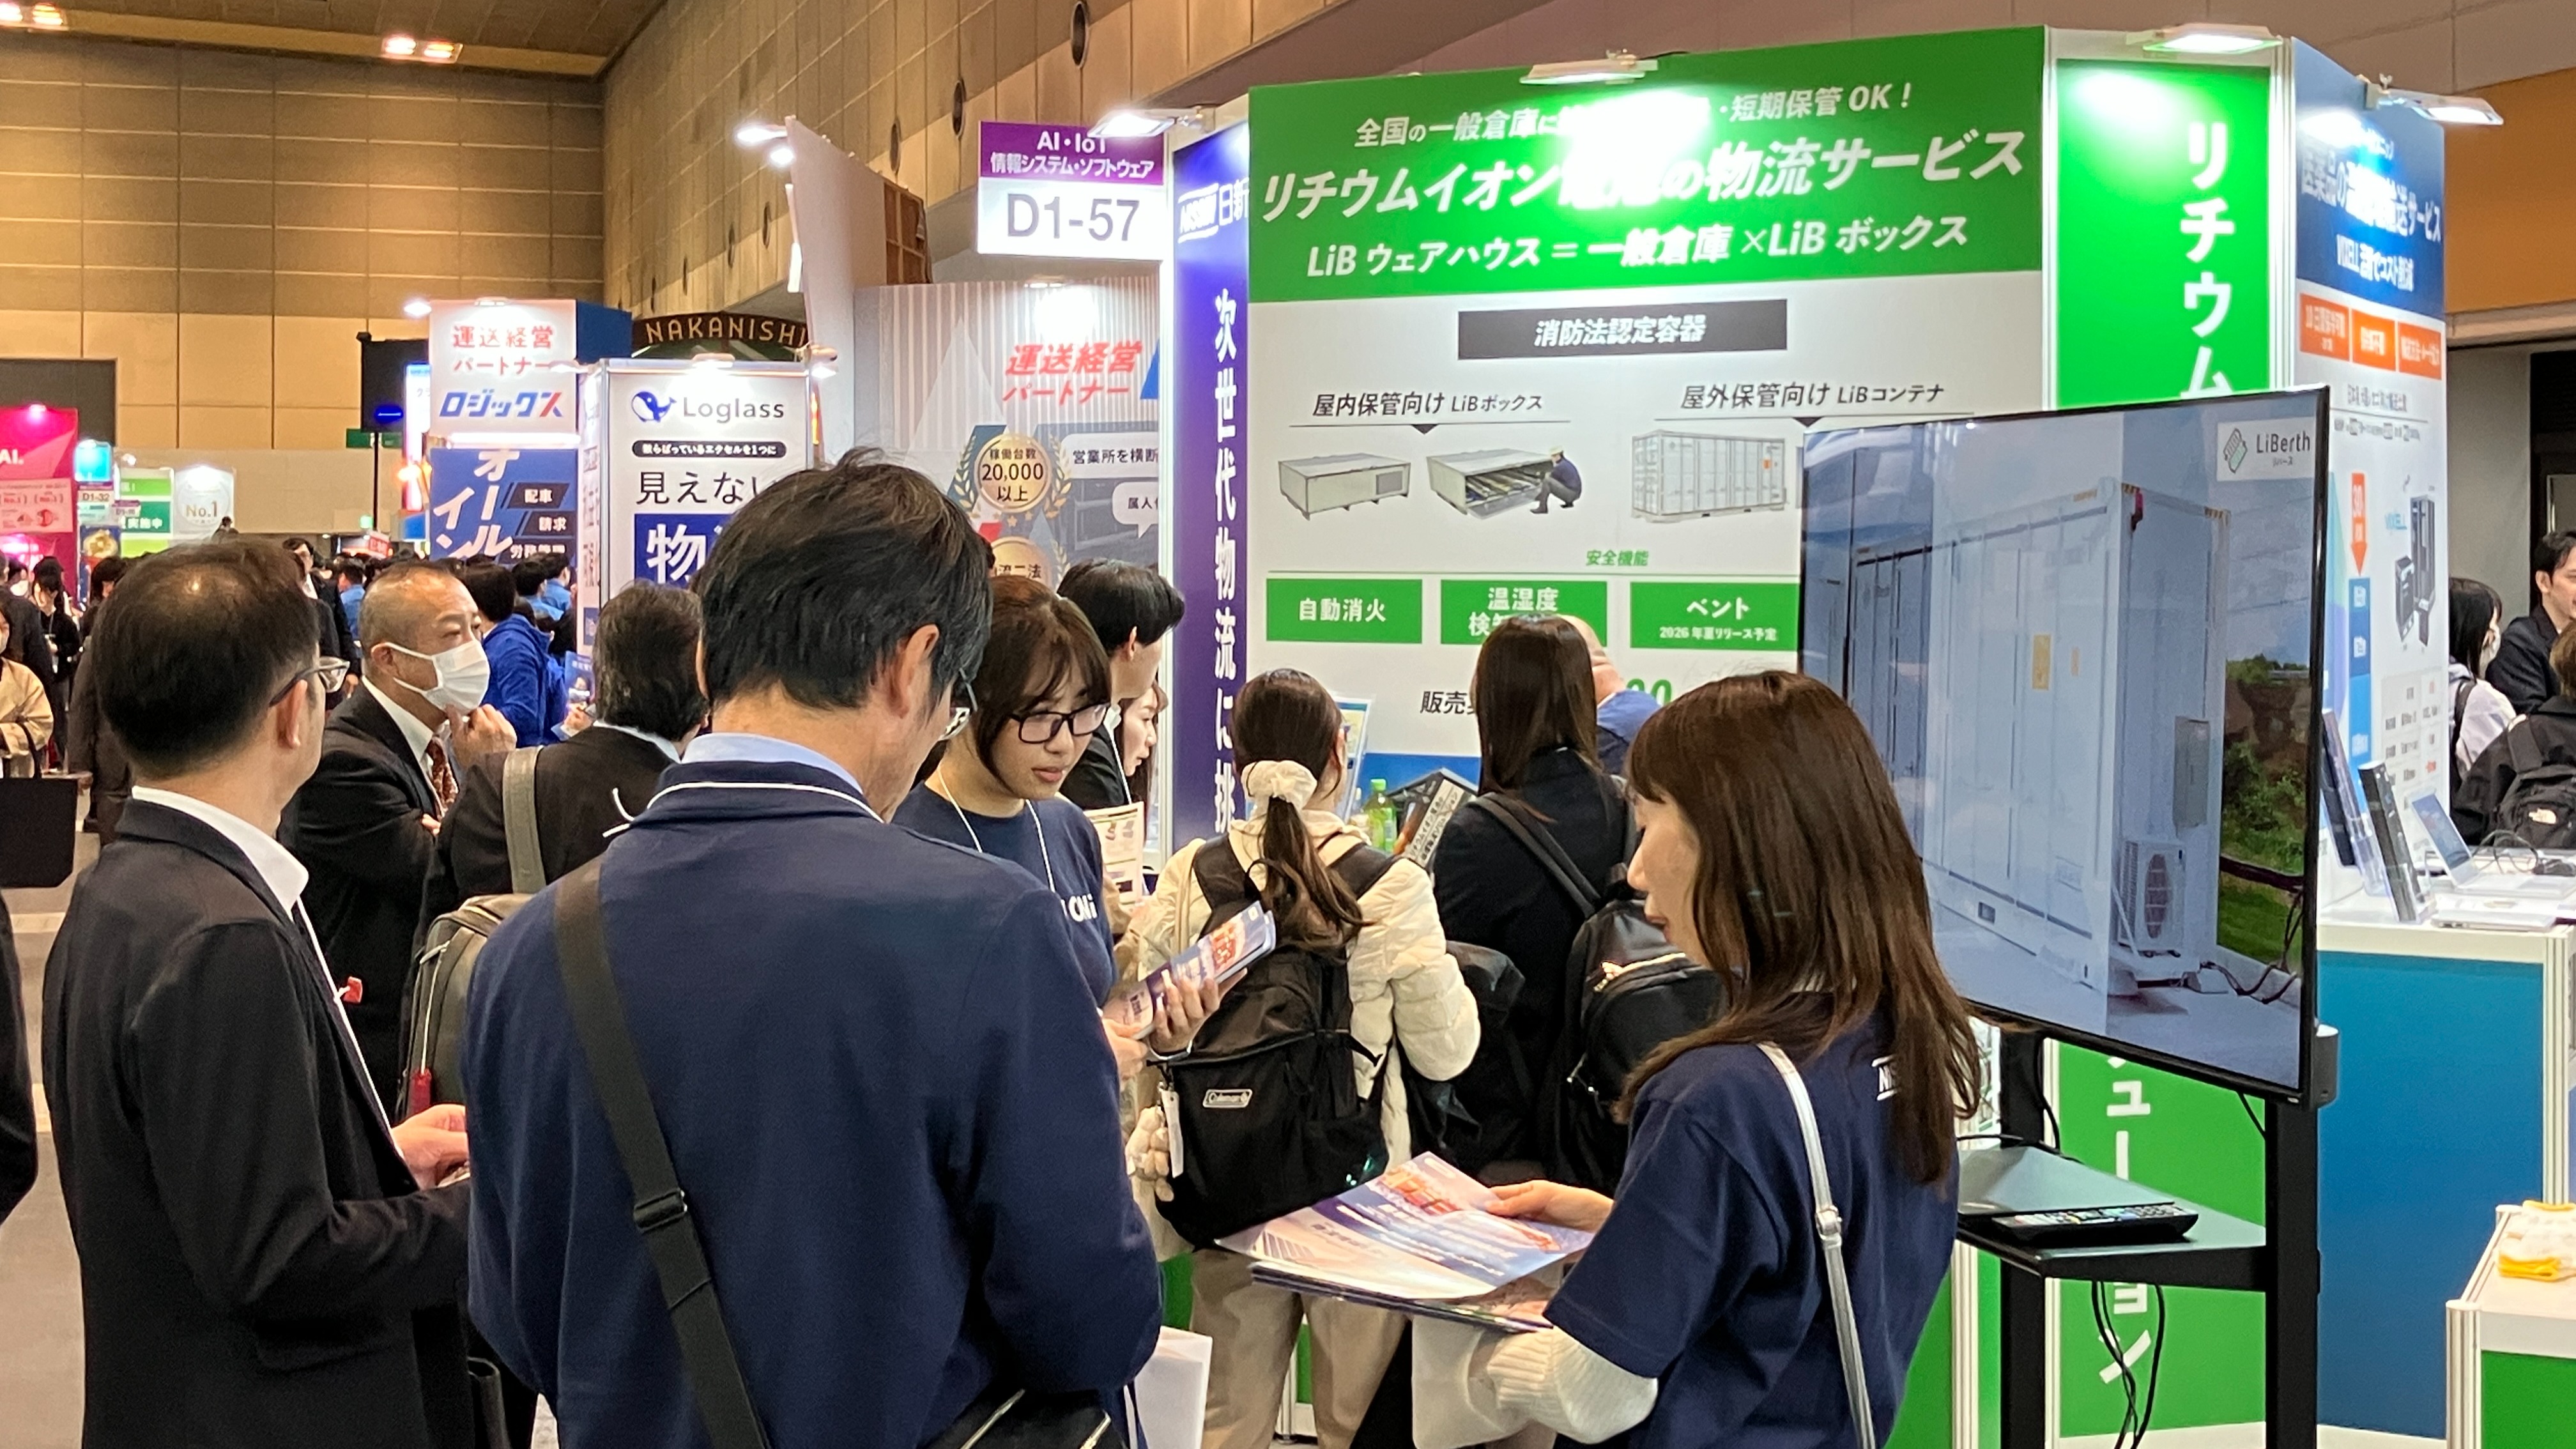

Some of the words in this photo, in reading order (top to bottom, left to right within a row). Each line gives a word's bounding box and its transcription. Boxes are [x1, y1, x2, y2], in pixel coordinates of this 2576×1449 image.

[990, 151, 1154, 179] 情報システム・ソフトウェア
[1263, 128, 2025, 222] リチウムイオンの物流サービス
[1007, 193, 1140, 241] D1-57
[2179, 121, 2235, 399] リチウム
[453, 325, 554, 349] 運送経営
[646, 317, 807, 347] NAKANISHI
[1534, 314, 1706, 347] 消防法認定容器
[454, 356, 551, 376] パートナー
[1005, 341, 1143, 376] 運送経営
[440, 388, 564, 417] ロジックス
[1002, 379, 1130, 406] パートナー
[683, 397, 785, 424] Loglass
[2256, 430, 2311, 454] LiBerth
[990, 448, 1037, 461] 稼働台数
[982, 463, 1043, 482] 20,000
[525, 489, 553, 503] 配車
[997, 486, 1028, 502] 以上
[186, 502, 218, 518] No.1
[539, 517, 567, 532] 請求
[1586, 550, 1649, 567] 安全機能
[1299, 597, 1386, 622] 自動消火
[1487, 587, 1559, 611] 温湿度
[1686, 596, 1750, 620] ベント
[1420, 691, 1476, 715] 販売
